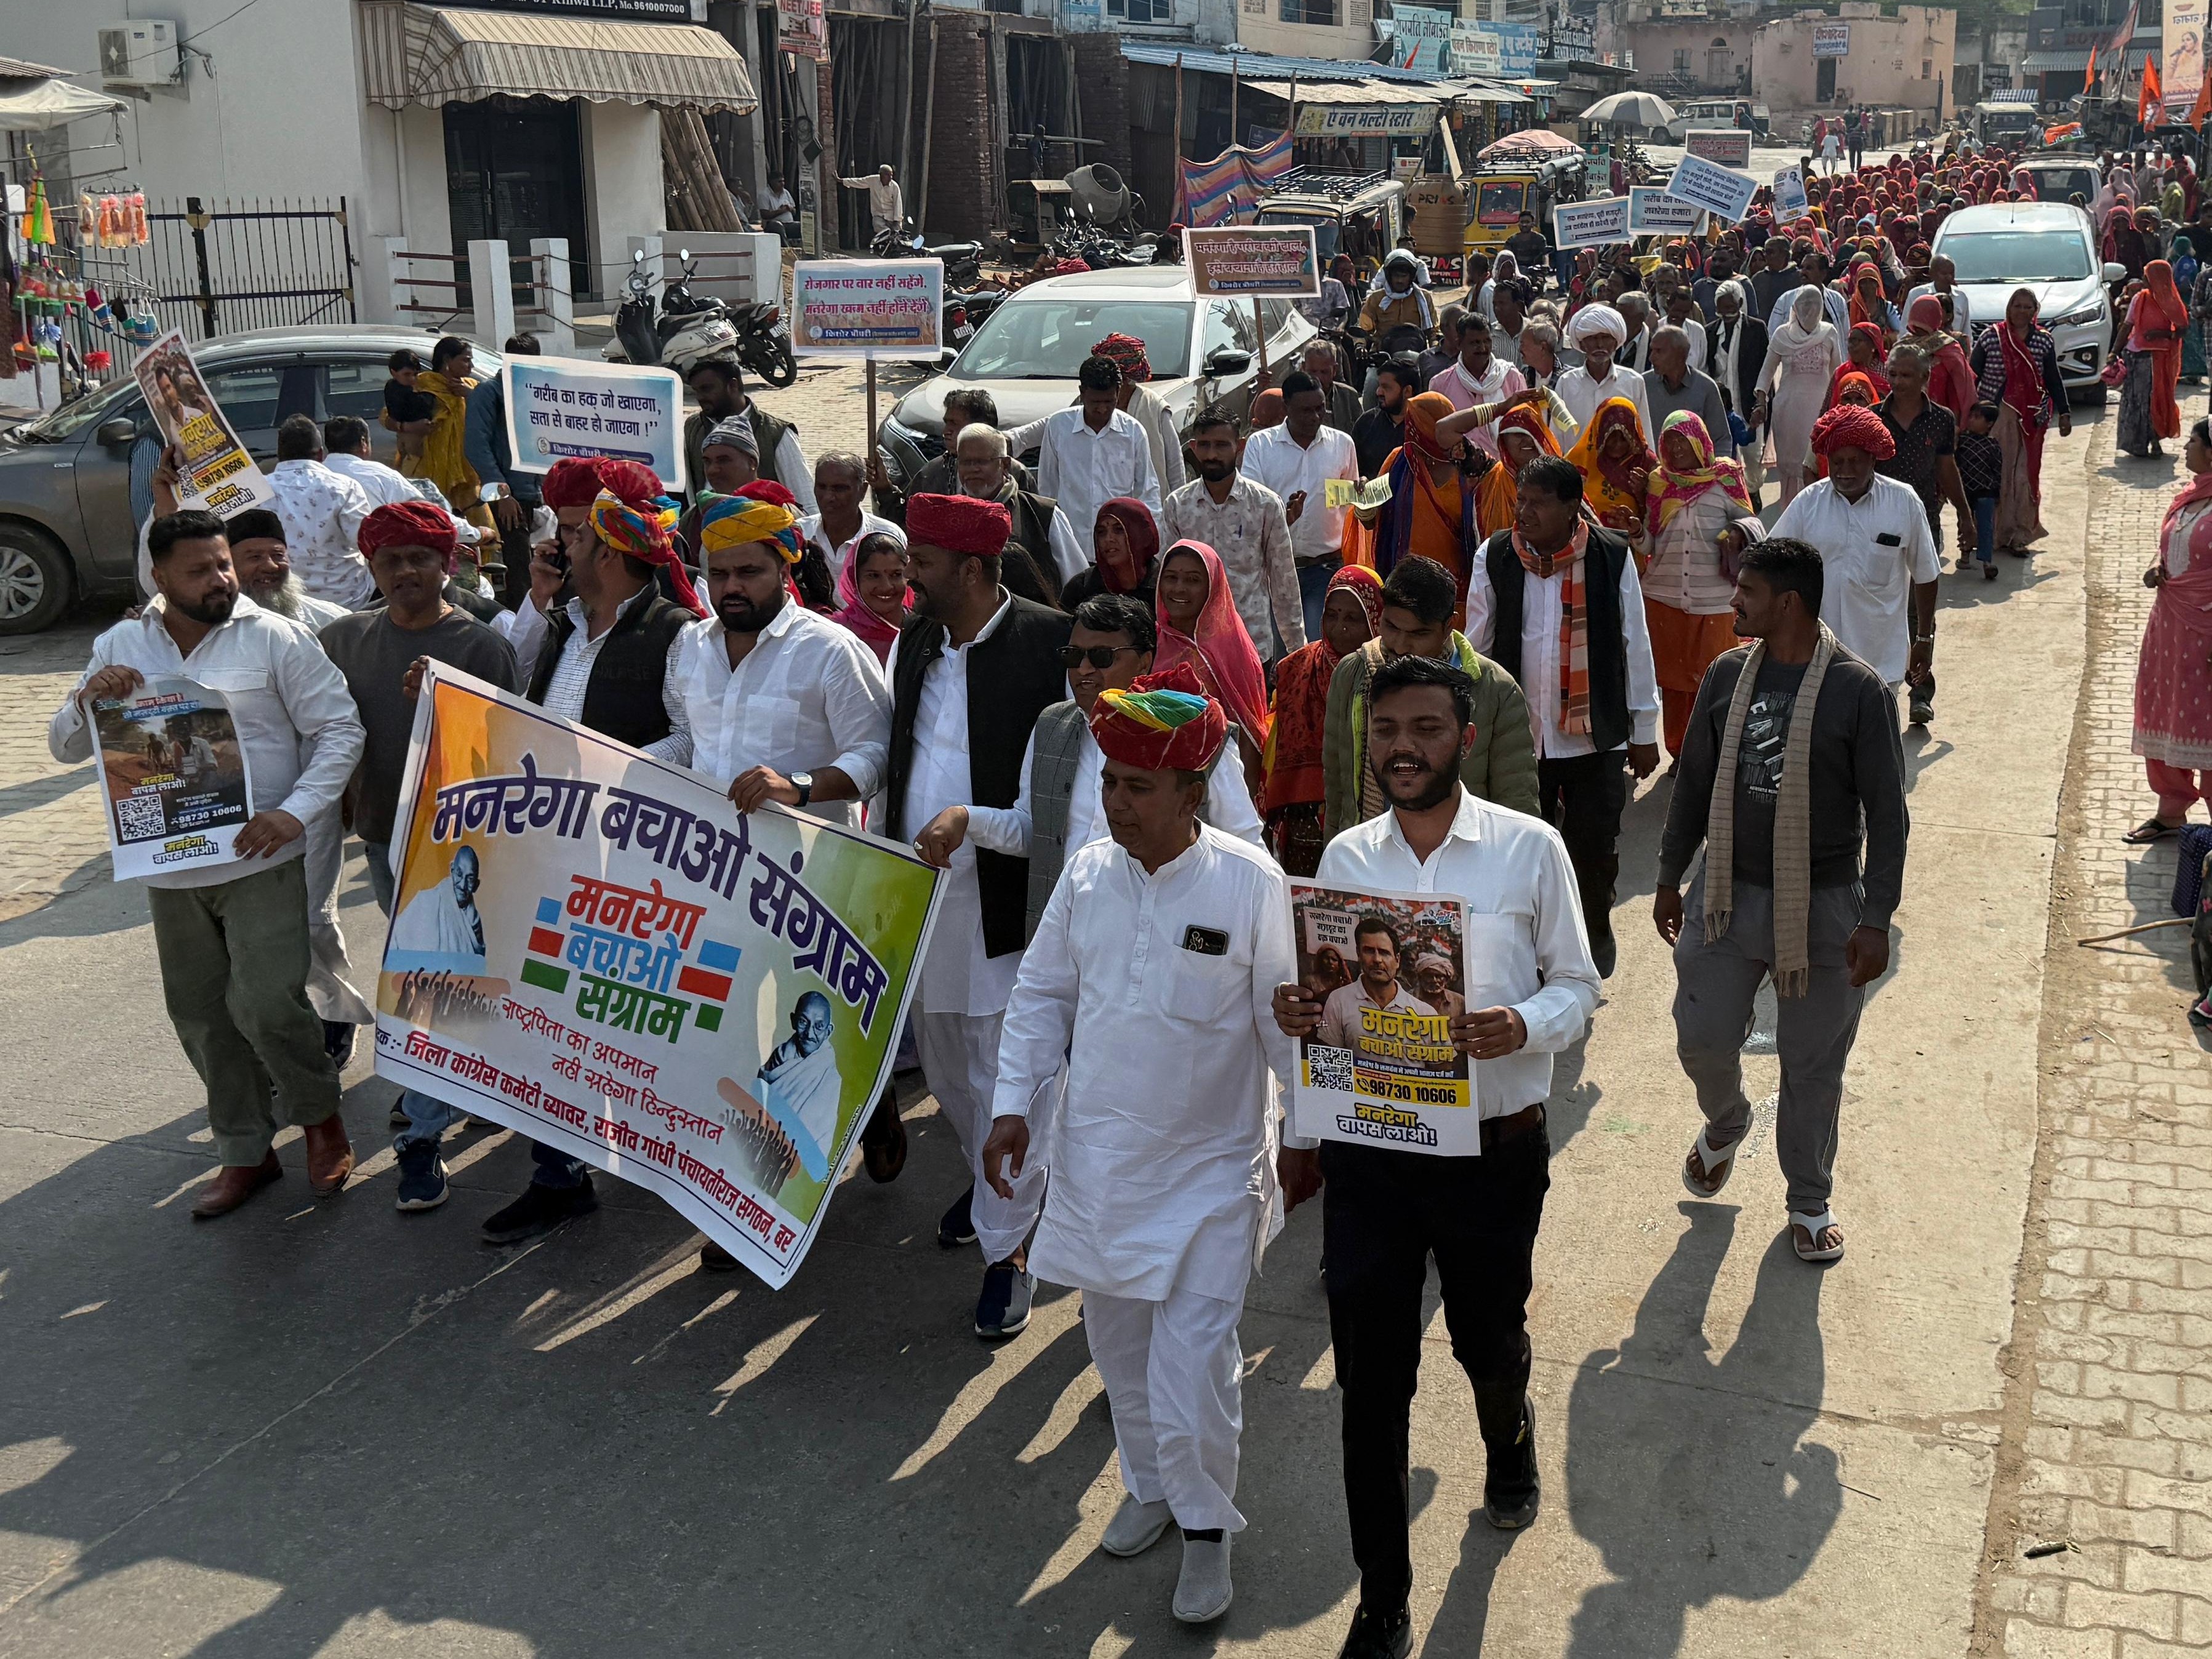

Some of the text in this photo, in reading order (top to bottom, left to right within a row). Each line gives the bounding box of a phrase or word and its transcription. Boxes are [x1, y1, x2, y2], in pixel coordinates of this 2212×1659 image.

[841, 279, 854, 289] पर
[856, 278, 873, 289] वार
[875, 275, 896, 291] नहीं
[805, 300, 838, 315] मनरेगा
[867, 299, 887, 315] नहीं
[825, 327, 849, 338] किशोर
[850, 327, 872, 338] चौधरी
[560, 390, 575, 404] का
[600, 389, 614, 409] जो
[618, 395, 661, 416] खाएगा,
[553, 409, 562, 428] से
[565, 414, 588, 431] बाहर
[591, 412, 602, 432] हो
[605, 419, 639, 436] जाएगा
[131, 777, 186, 795] वापस लाओ!
[140, 773, 175, 785] मनरेगा
[178, 811, 209, 824] 98730
[212, 805, 242, 817] 10606
[153, 840, 218, 864] वापस लाओ!
[164, 835, 206, 853] मनरेगा
[432, 753, 891, 1032] मनरेगा बचाओ संग्राम
[566, 875, 707, 950] मनरेगा
[566, 923, 684, 994] बचाओ
[575, 966, 692, 1039] संग्राम
[1359, 1006, 1451, 1042] मनरेगा
[501, 997, 660, 1084] राष्ट्रपिता का अपमान
[1358, 1034, 1455, 1062] बचाओ संग्राम
[1369, 1079, 1457, 1104] 98730 10606
[584, 1068, 639, 1107] सहेगा
[641, 1087, 725, 1146] हिन्दुस्तान
[1355, 1103, 1418, 1129] मनरेगा
[404, 1030, 452, 1068] जिला
[450, 1051, 501, 1088] कांग्रेस
[500, 1074, 542, 1108] कमेटी
[543, 1093, 589, 1134] ब्यावर,
[594, 1115, 640, 1152] राजीव
[641, 1135, 676, 1168] गांधी
[678, 1149, 742, 1211] पंचायतीराज
[735, 1194, 776, 1243] संगठन,
[774, 1223, 796, 1253] बर
[1337, 1115, 1437, 1147] वापस लाओ!
